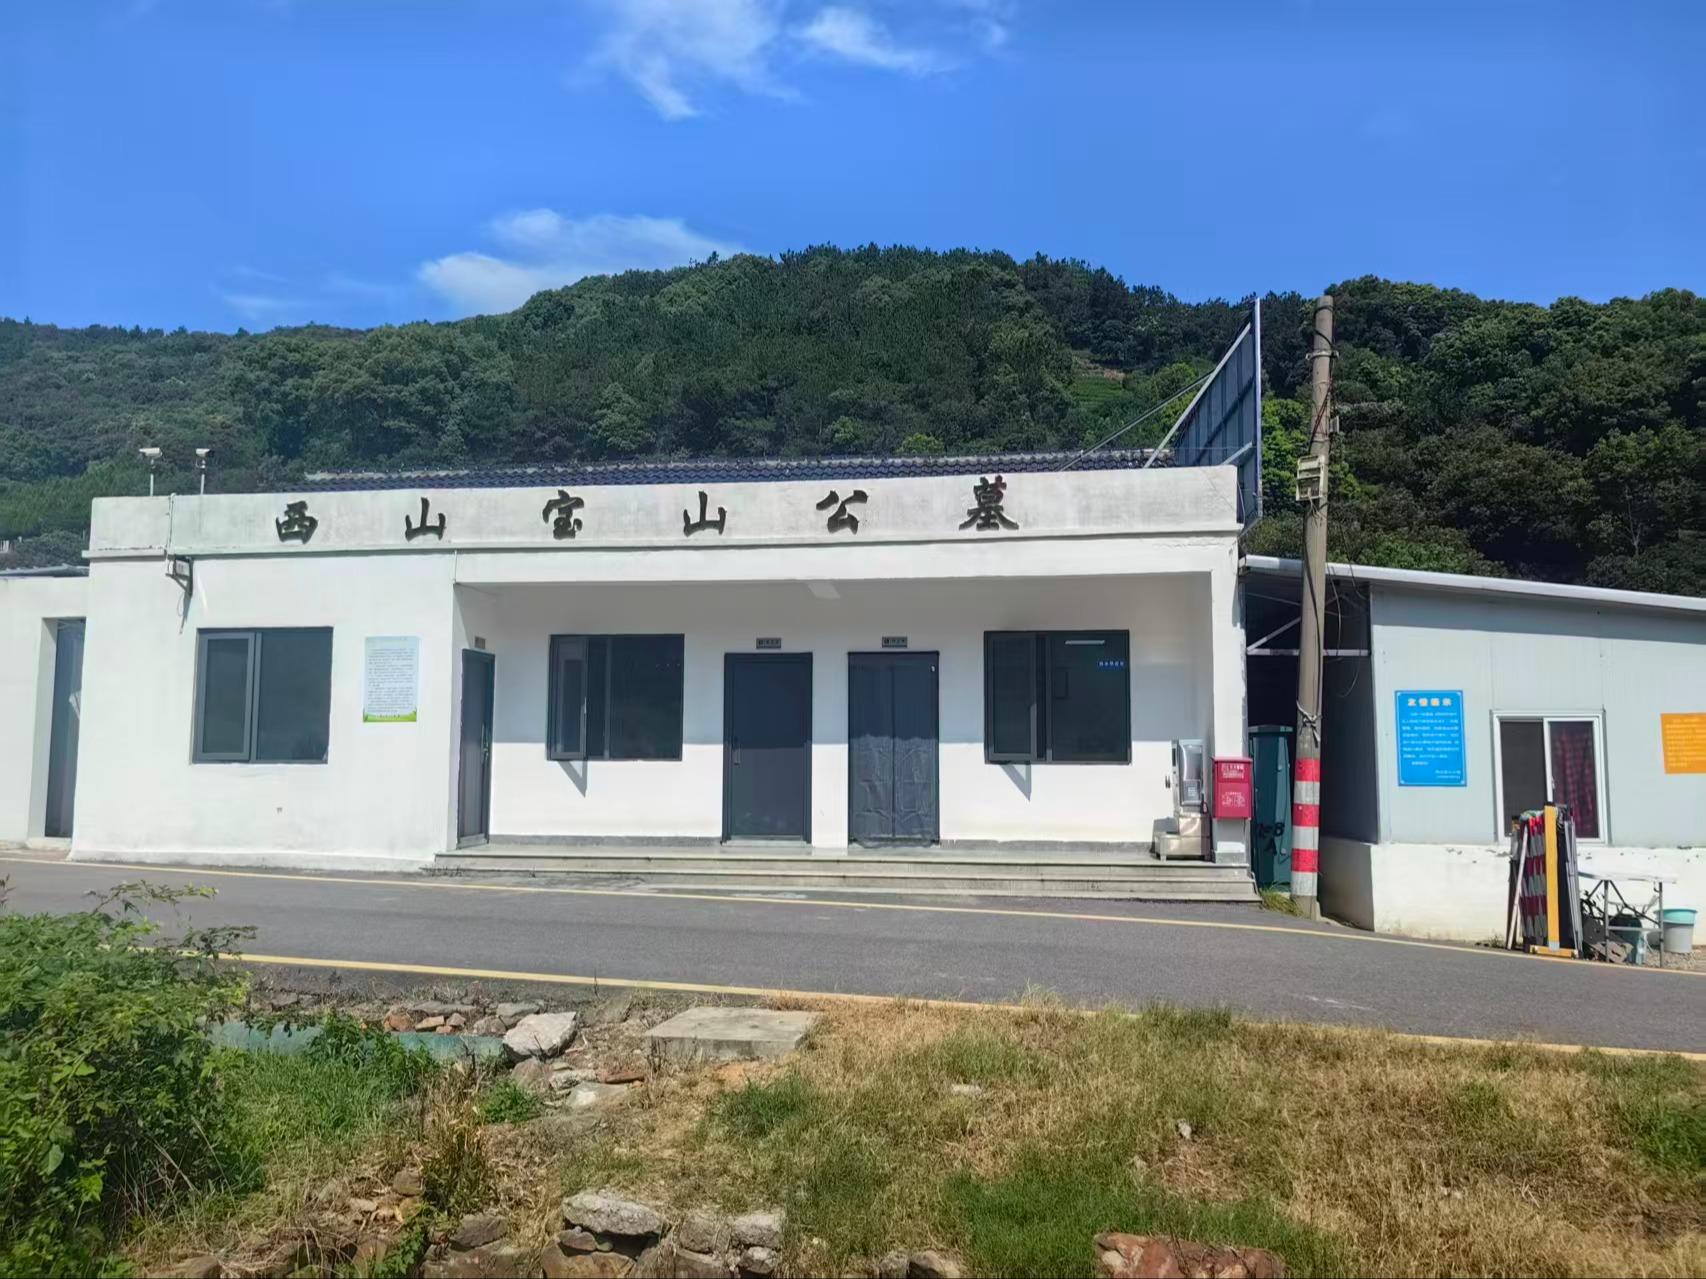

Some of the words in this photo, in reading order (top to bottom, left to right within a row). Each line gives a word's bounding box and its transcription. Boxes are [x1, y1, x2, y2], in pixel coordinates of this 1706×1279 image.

[276, 475, 1019, 543] 西山宝山公墓
